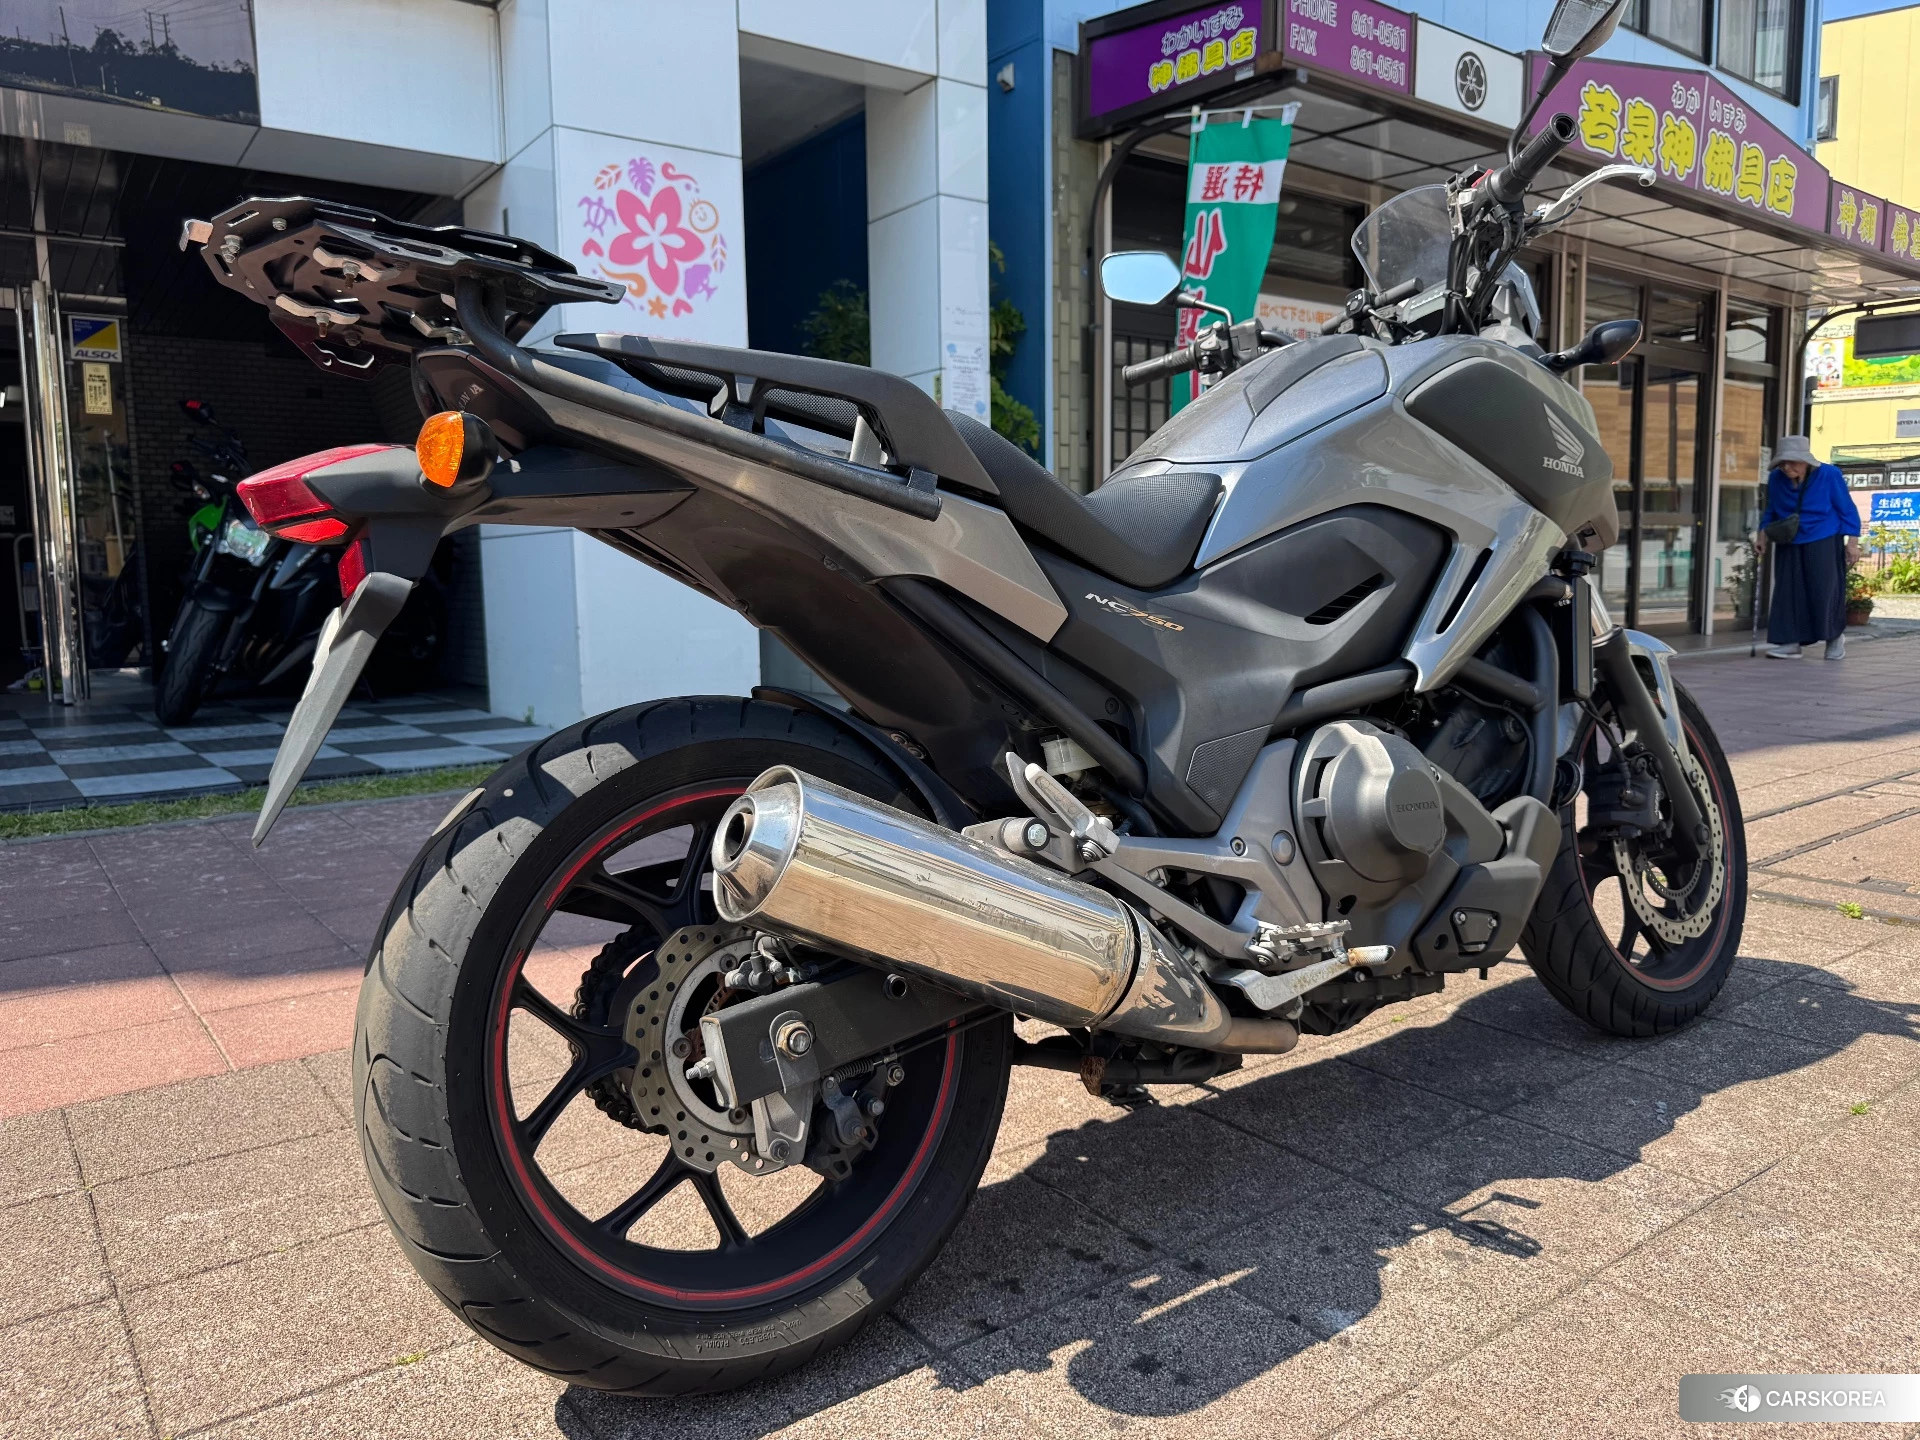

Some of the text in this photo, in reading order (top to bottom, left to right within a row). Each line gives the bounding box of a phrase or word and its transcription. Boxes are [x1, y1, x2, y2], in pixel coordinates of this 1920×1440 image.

[1351, 10, 1406, 52] 861-0561
[1290, 23, 1405, 86] FAX 861-0561
[75, 349, 118, 360] ALSOK
[1542, 456, 1584, 478] HONDA
[1878, 497, 1913, 508] 生活者
[1874, 508, 1916, 518] ファースト
[1085, 593, 1185, 632] NC750
[1396, 800, 1438, 812] HONDA
[704, 1339, 729, 1348] RADIAL
